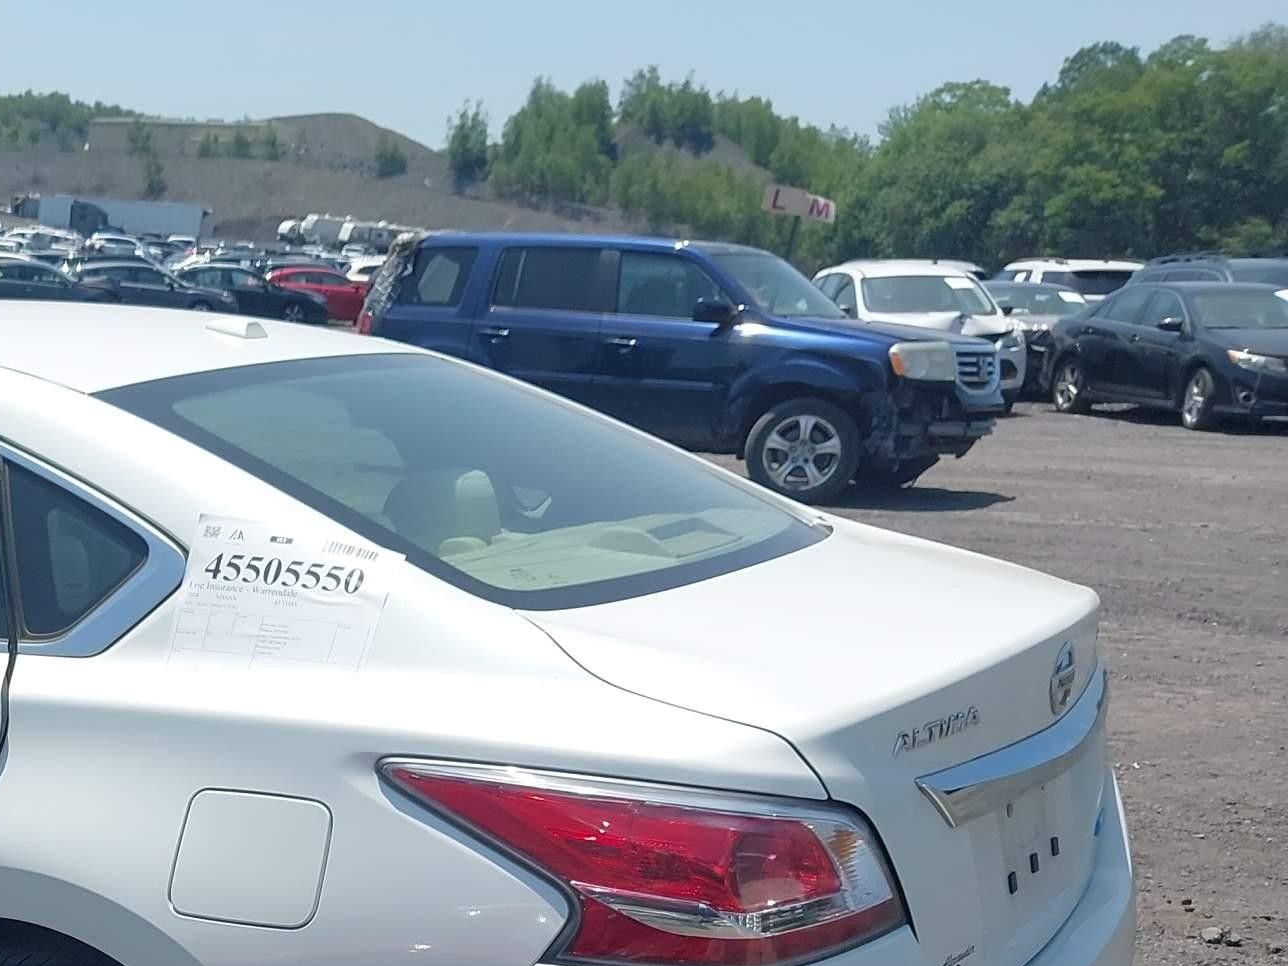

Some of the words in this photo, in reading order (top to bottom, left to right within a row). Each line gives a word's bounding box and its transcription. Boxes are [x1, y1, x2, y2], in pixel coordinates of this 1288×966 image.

[772, 189, 786, 211] L
[809, 199, 830, 219] M
[204, 552, 365, 594] 45505550
[206, 582, 244, 593] Insurance
[252, 585, 299, 598] Warrendale
[892, 705, 980, 757] ALTIMA
